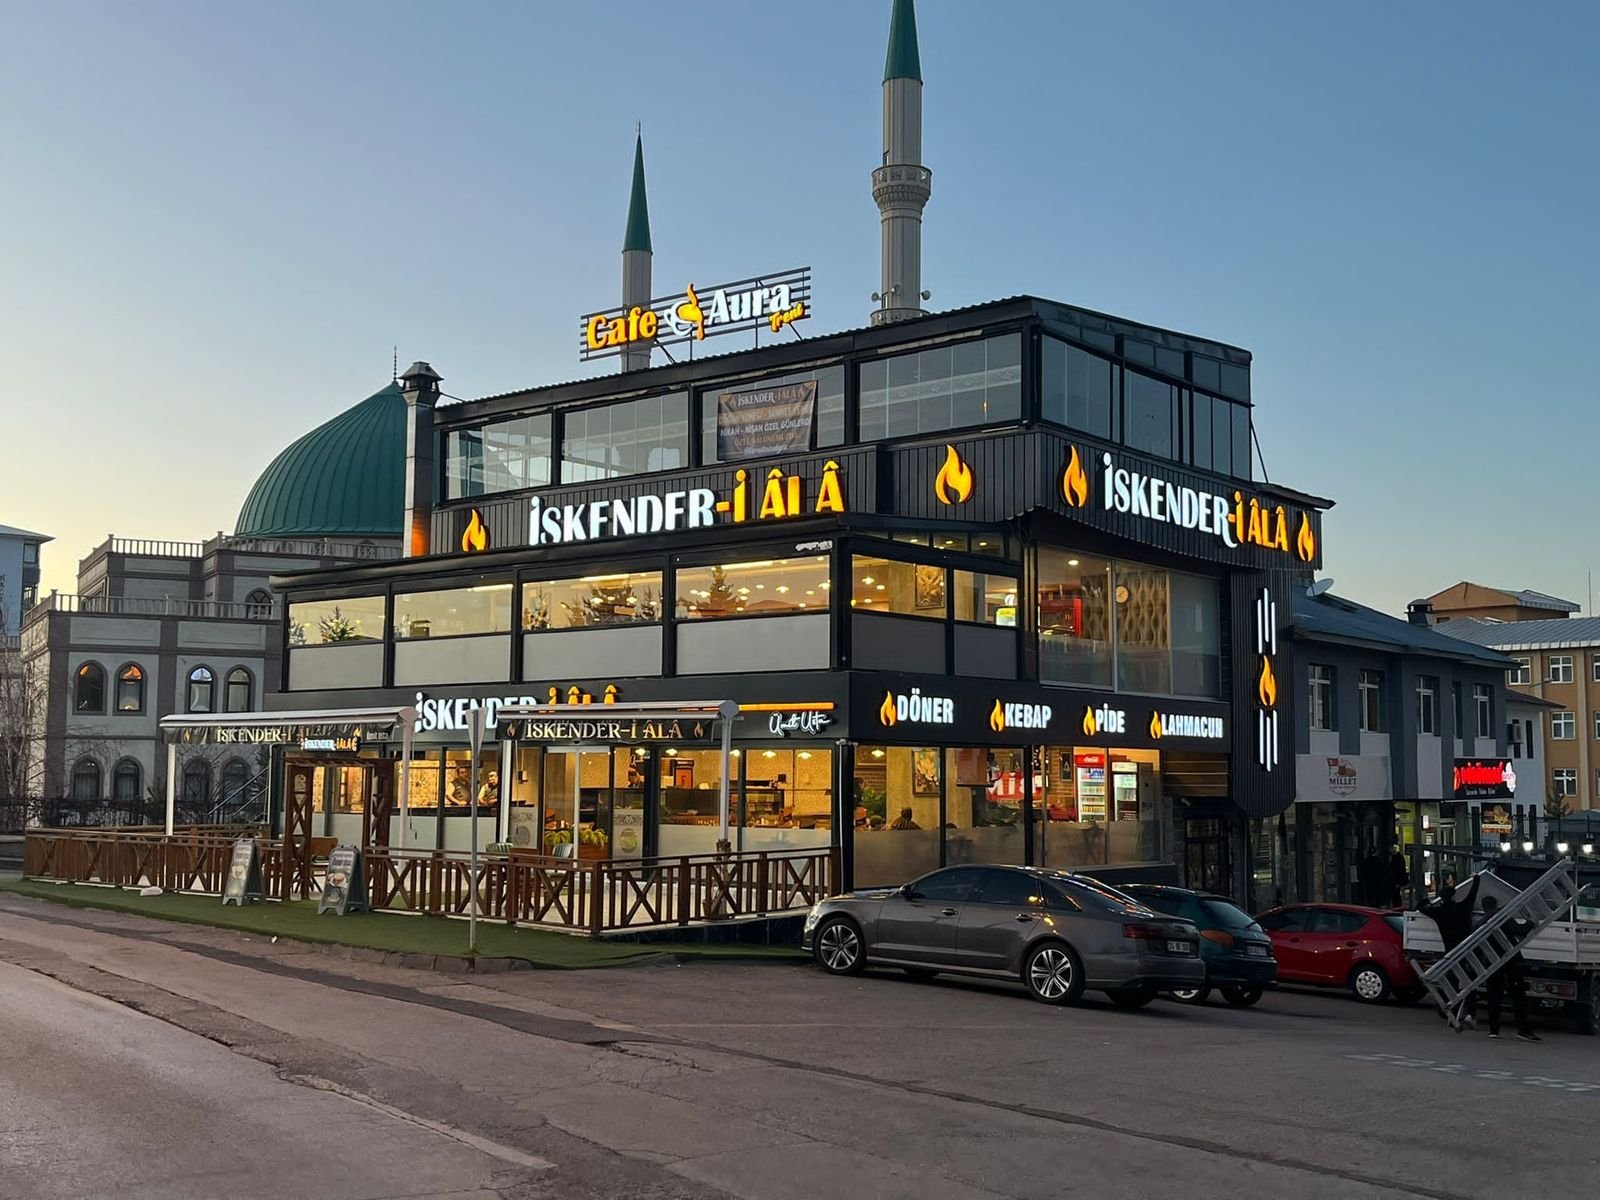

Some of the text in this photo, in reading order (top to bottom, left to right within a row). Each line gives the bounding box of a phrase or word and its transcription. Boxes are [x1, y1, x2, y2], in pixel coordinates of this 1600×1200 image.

[587, 283, 793, 350] Cafe Aura
[897, 688, 954, 724] DÖNER
[1004, 702, 1051, 729] KEBAP
[1095, 703, 1125, 733] PİDE
[1161, 713, 1224, 739] LAHMACUN
